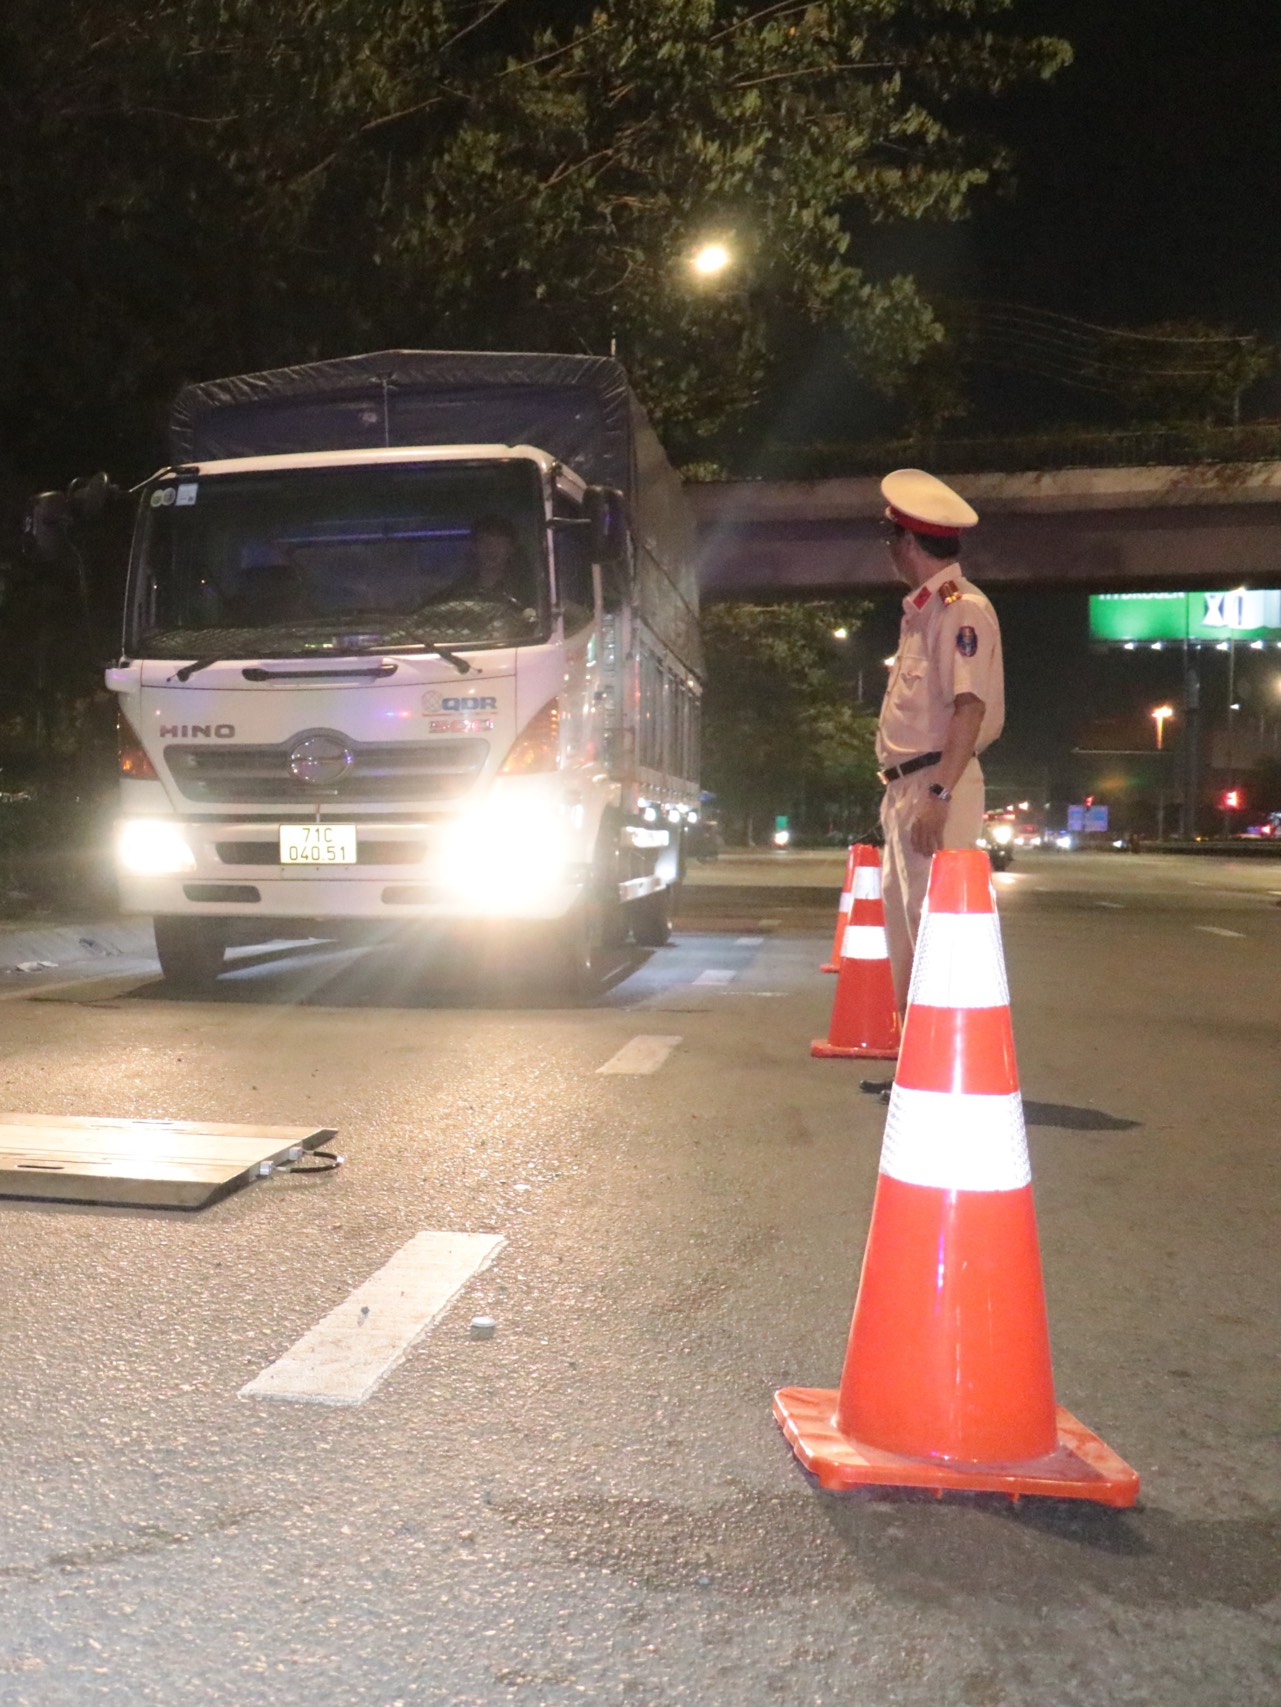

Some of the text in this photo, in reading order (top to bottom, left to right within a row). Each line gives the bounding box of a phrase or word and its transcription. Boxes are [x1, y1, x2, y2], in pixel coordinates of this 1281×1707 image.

[441, 696, 497, 712] QDR
[160, 724, 235, 739] HINO
[302, 828, 333, 842] 71C
[289, 846, 346, 861] 040.51
